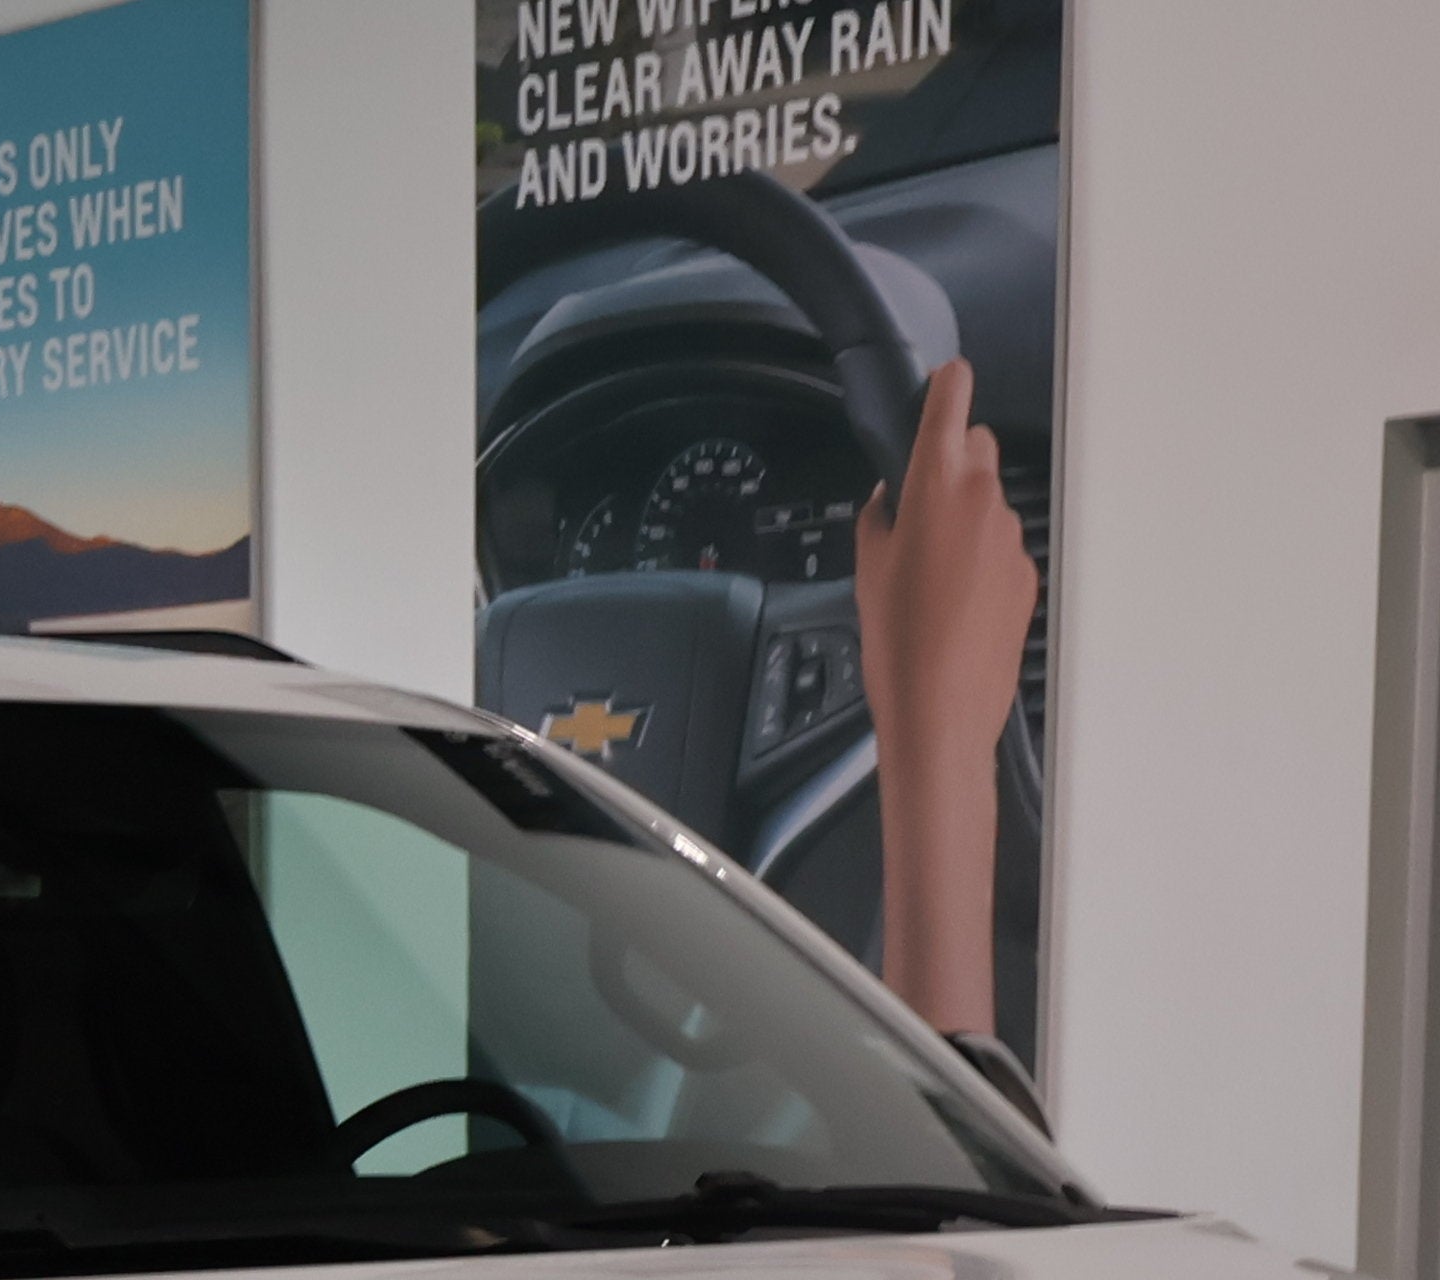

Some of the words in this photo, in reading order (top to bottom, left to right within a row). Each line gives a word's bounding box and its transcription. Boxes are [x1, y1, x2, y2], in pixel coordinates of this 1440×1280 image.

[517, 0, 619, 62] NEW
[517, 51, 663, 136] CLEAR
[676, 16, 816, 108] AWAY
[830, 0, 952, 77] RAIN
[28, 116, 124, 191] ONLY
[516, 137, 608, 210] AND
[622, 92, 860, 193] WORRIES.
[69, 174, 184, 251] WHEN
[49, 262, 96, 322] TO
[41, 313, 201, 394] SERVICE
